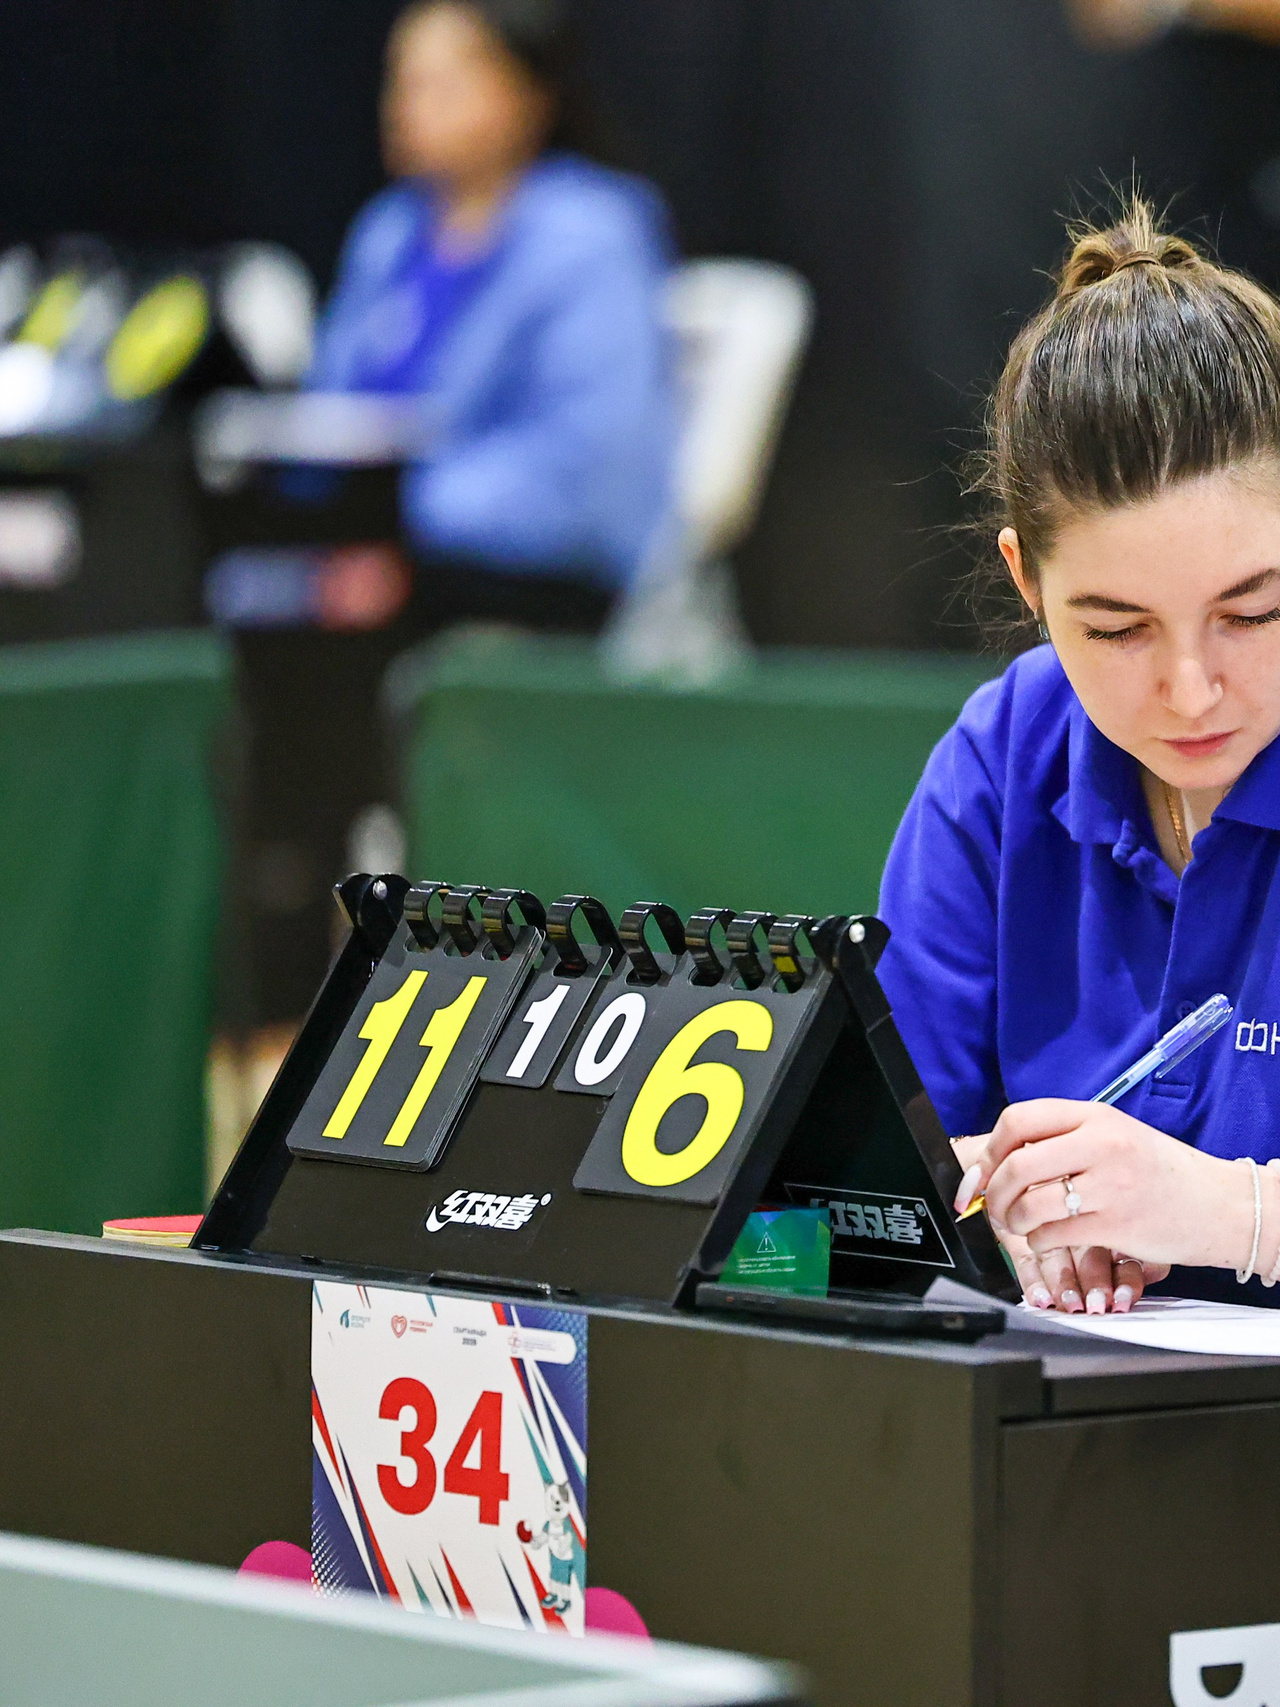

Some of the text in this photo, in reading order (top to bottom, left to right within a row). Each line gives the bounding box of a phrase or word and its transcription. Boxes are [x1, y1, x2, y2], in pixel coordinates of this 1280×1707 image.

[322, 970, 773, 1187] 11 1 0 6
[377, 1377, 509, 1526] 34
